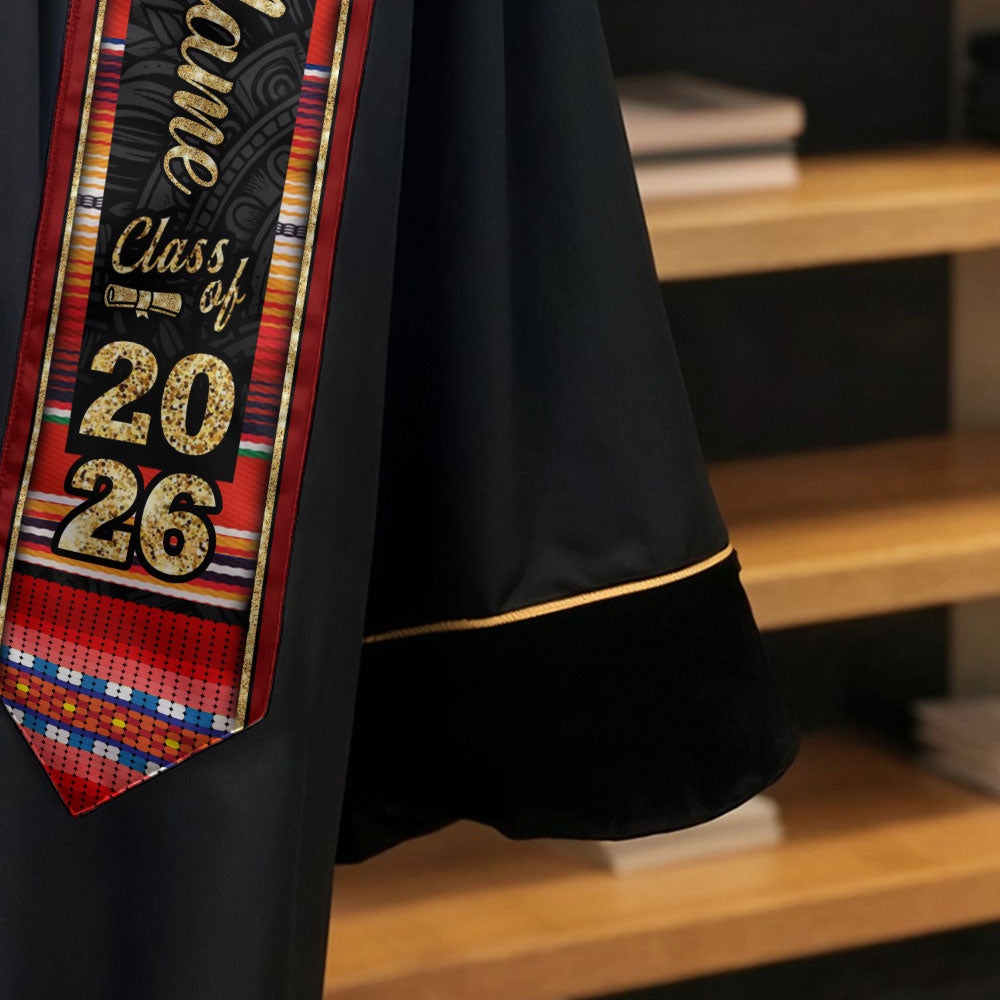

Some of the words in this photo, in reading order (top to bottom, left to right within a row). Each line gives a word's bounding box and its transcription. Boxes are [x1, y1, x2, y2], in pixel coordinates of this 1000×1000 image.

[112, 217, 229, 275] Class
[201, 258, 248, 332] of
[79, 340, 235, 456] 20
[58, 459, 216, 576] 26
